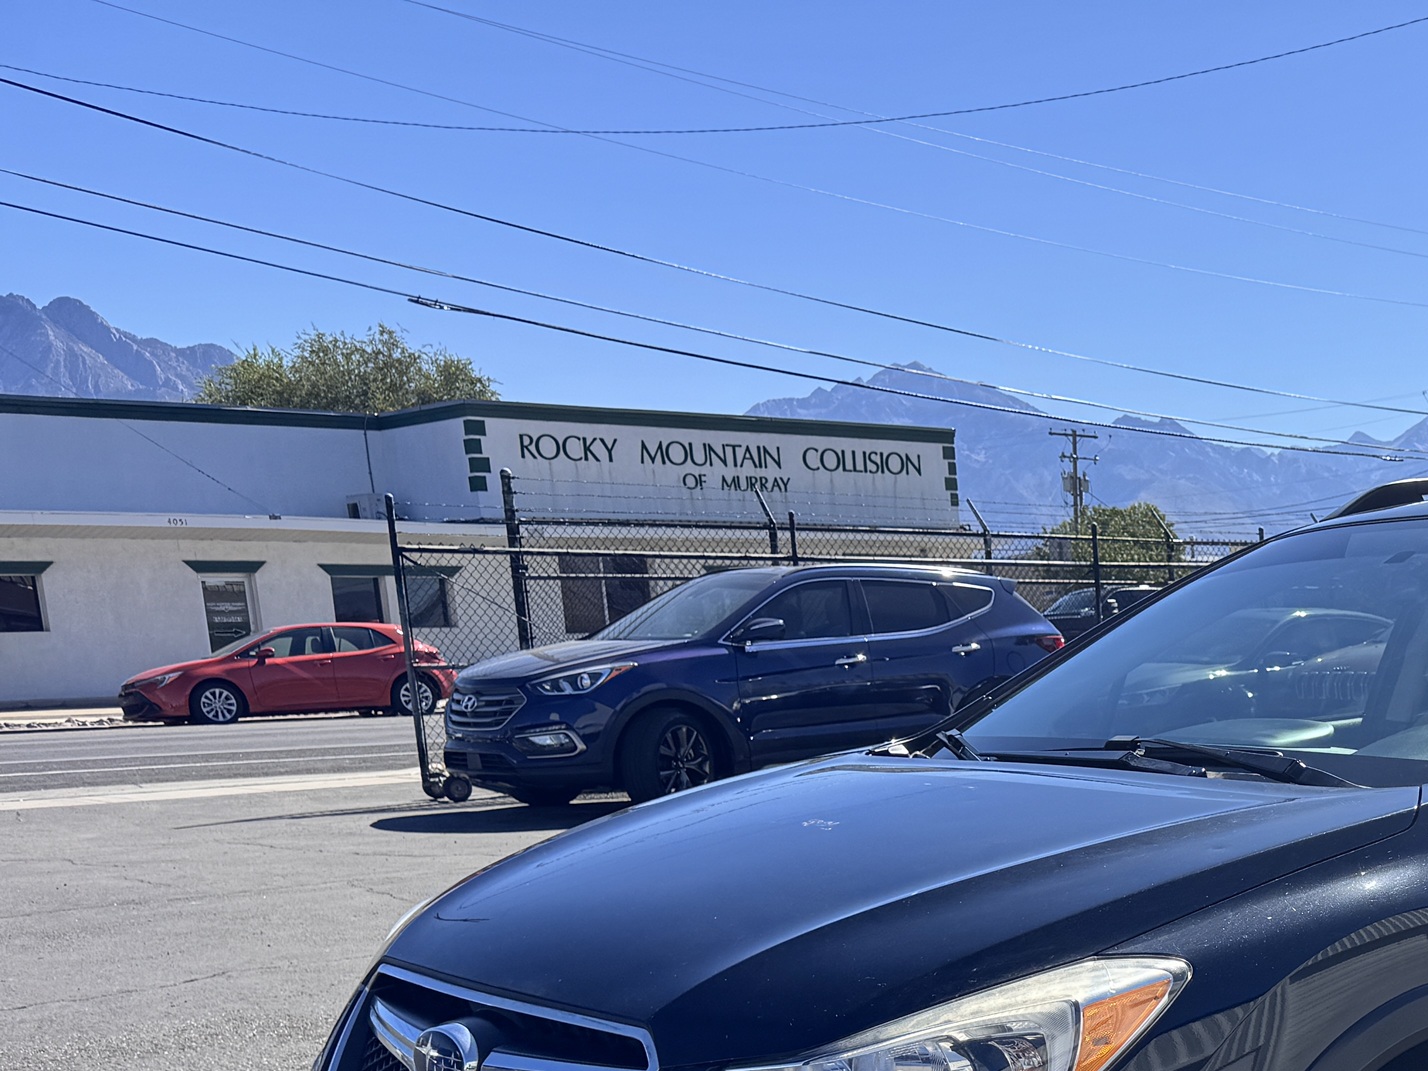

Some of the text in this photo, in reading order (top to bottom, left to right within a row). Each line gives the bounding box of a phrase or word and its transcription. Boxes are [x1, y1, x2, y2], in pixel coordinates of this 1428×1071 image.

[518, 433, 922, 477] ROCKY MOUNTAIN COLLISION
[682, 472, 791, 494] OF MURRAY
